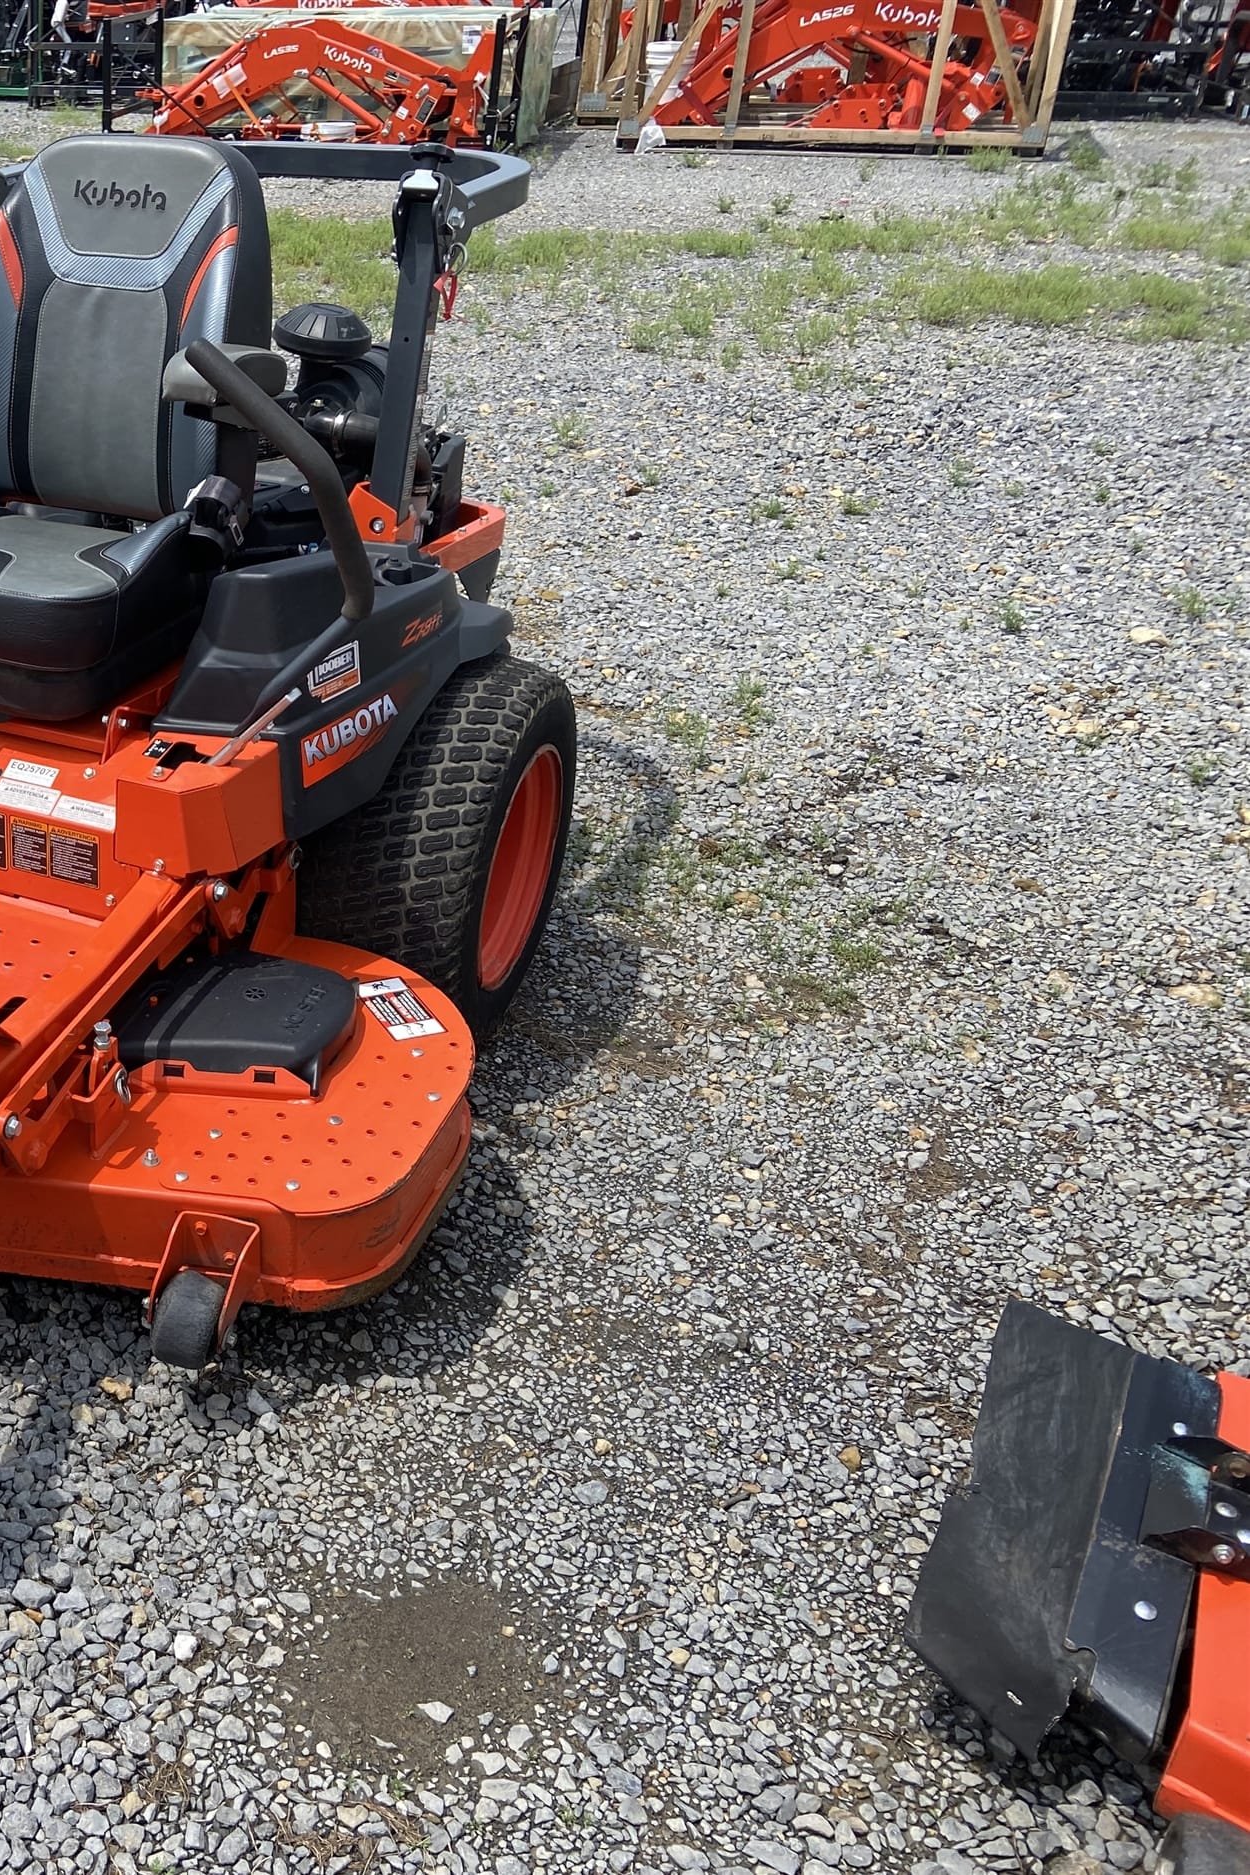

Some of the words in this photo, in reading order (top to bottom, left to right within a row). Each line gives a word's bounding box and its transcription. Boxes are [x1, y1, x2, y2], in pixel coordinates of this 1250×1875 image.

[800, 4, 855, 27] LA526
[324, 45, 372, 74] Kubota
[73, 179, 167, 211] Kubota
[303, 693, 399, 768] KUBOTA
[10, 761, 57, 778] EQ257072
